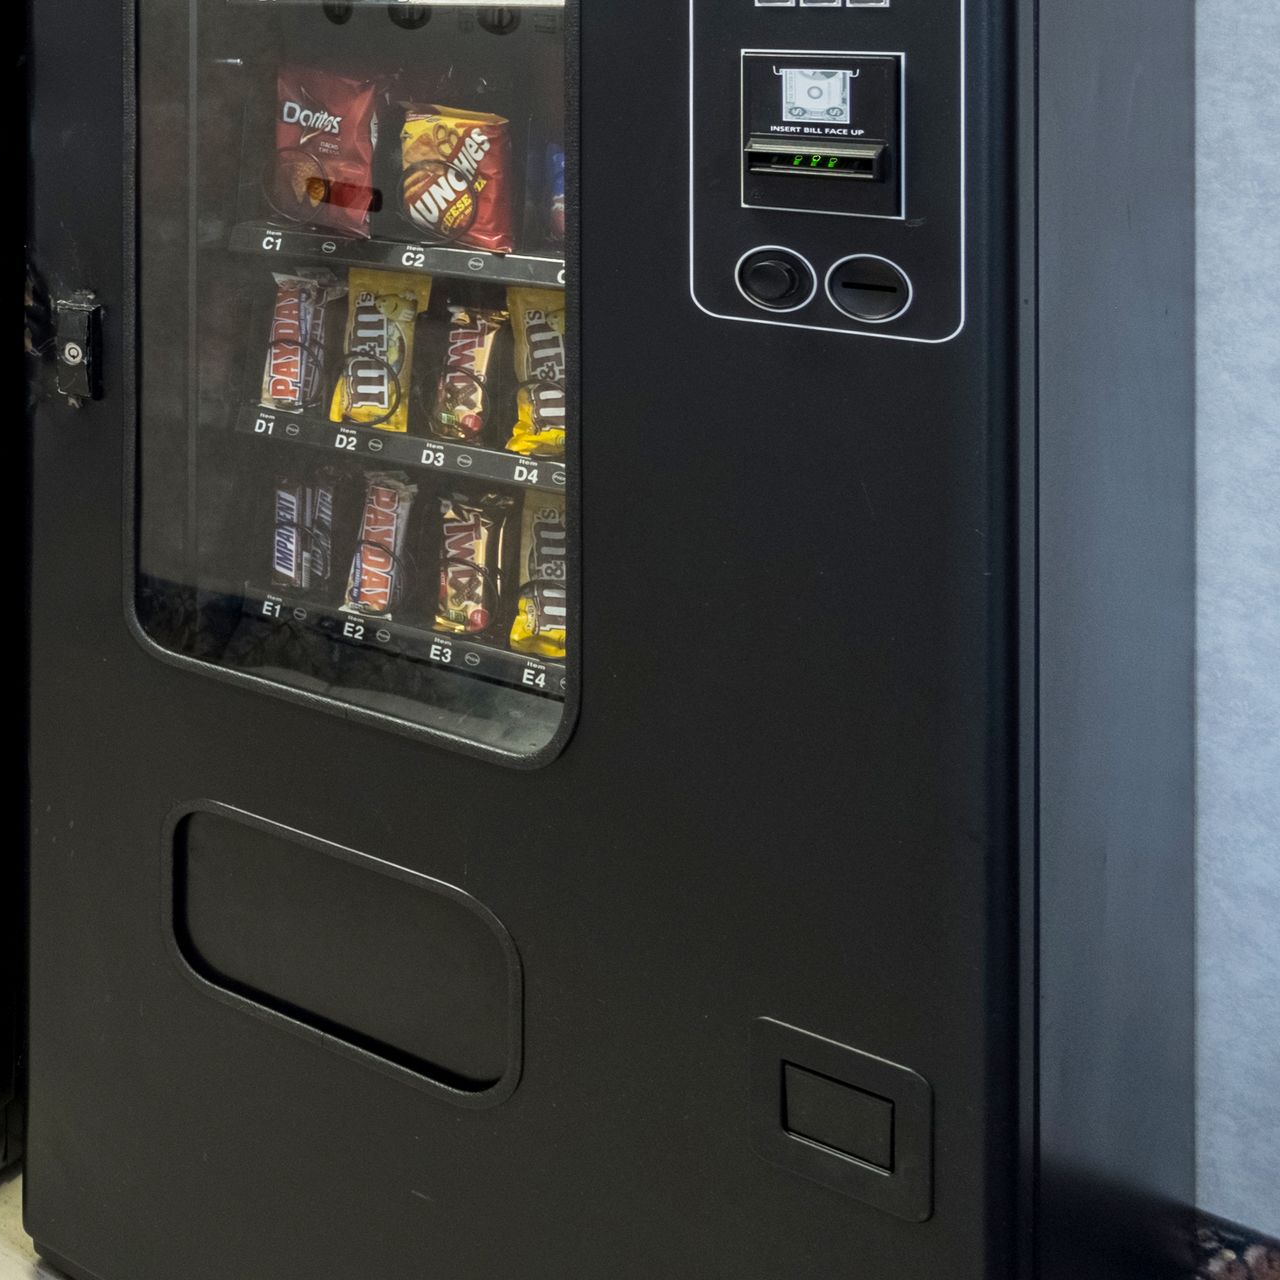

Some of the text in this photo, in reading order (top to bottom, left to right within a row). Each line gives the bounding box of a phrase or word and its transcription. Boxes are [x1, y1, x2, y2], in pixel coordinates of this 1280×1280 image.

[282, 101, 342, 135] Doritos
[770, 125, 864, 136] INSERT BILL FACE UP
[262, 236, 283, 251] C1
[401, 252, 425, 268] C2
[269, 286, 302, 401] PAYDAY
[254, 419, 275, 436] D1
[340, 427, 357, 435] Item
[334, 434, 357, 451] D2
[426, 442, 444, 450] Item
[421, 449, 445, 467] D3
[518, 458, 538, 466] Item
[513, 466, 539, 484] D4
[360, 486, 400, 611] PAYDAY
[262, 601, 281, 618] E1
[342, 623, 365, 640] E2
[434, 637, 452, 646] Item
[429, 646, 452, 663] E3
[527, 661, 546, 670] Item
[522, 669, 547, 688] E4
